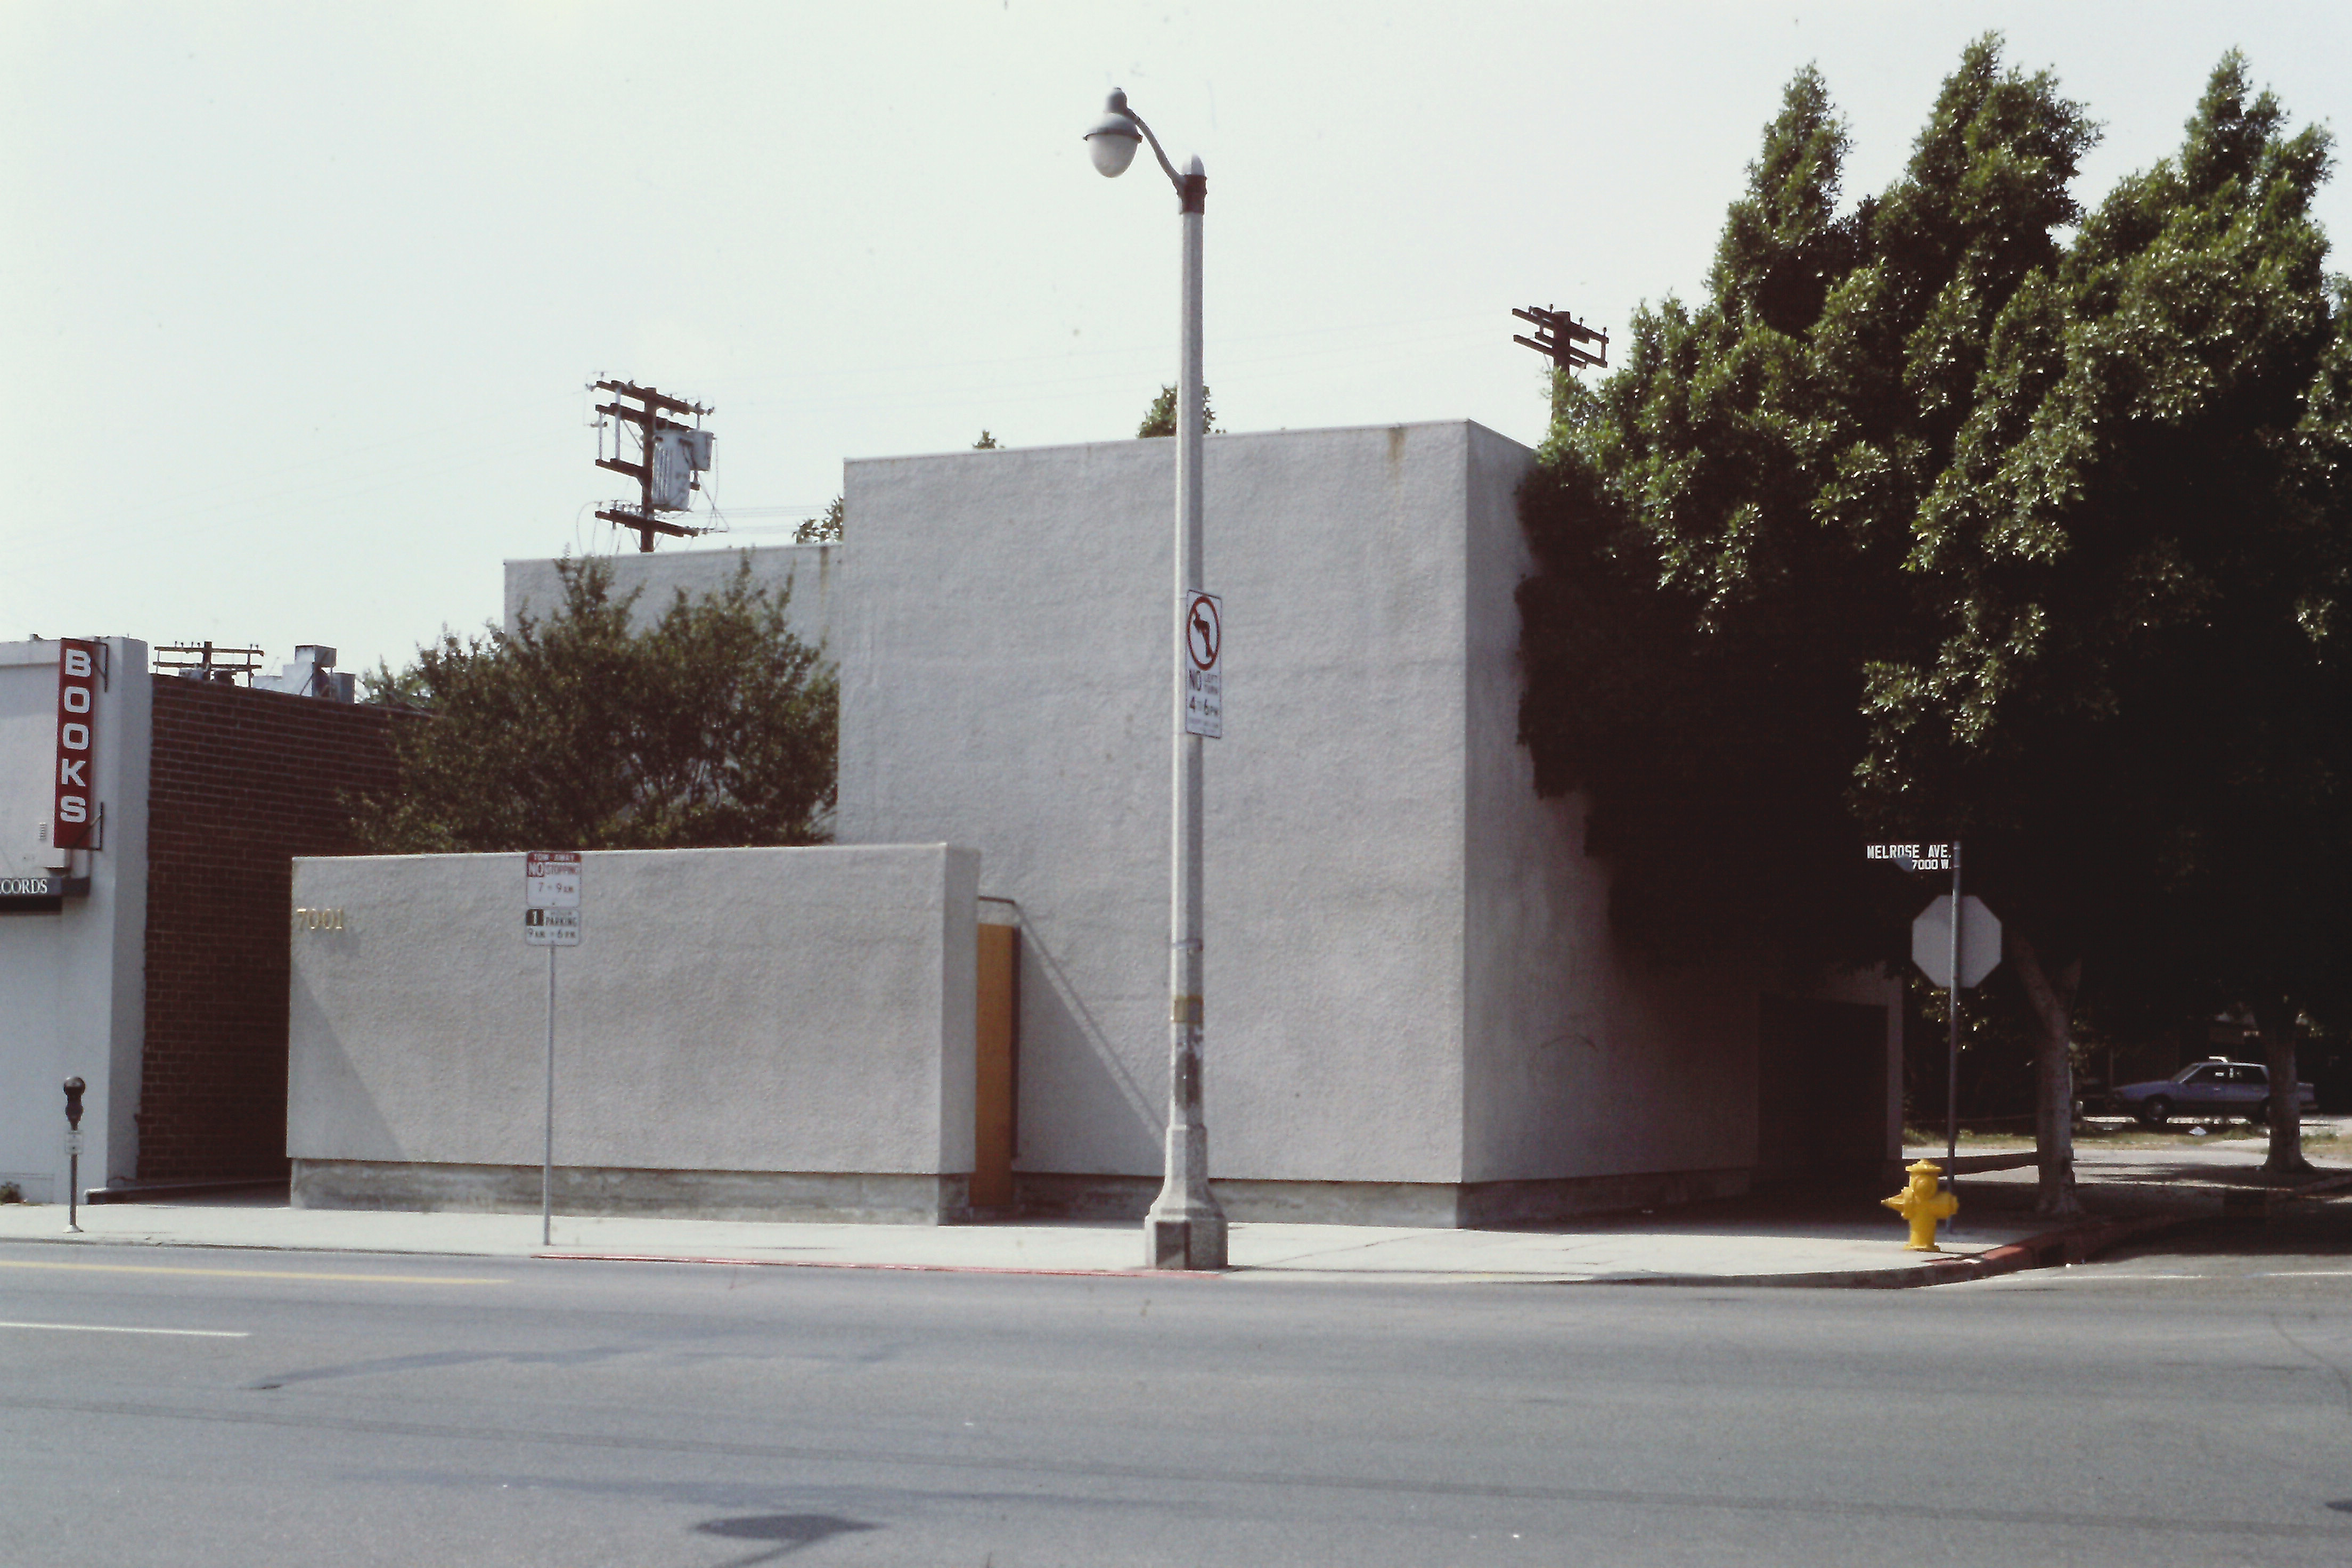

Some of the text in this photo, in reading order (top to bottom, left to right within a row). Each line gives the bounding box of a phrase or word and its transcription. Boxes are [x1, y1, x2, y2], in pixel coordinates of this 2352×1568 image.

[1189, 669, 1202, 692] NO
[60, 648, 92, 823] BOOKS
[1866, 844, 1951, 859] MELROSE AVE.
[528, 862, 544, 876] NO
[1912, 859, 1938, 870] 7000
[0, 878, 48, 894] CORDS
